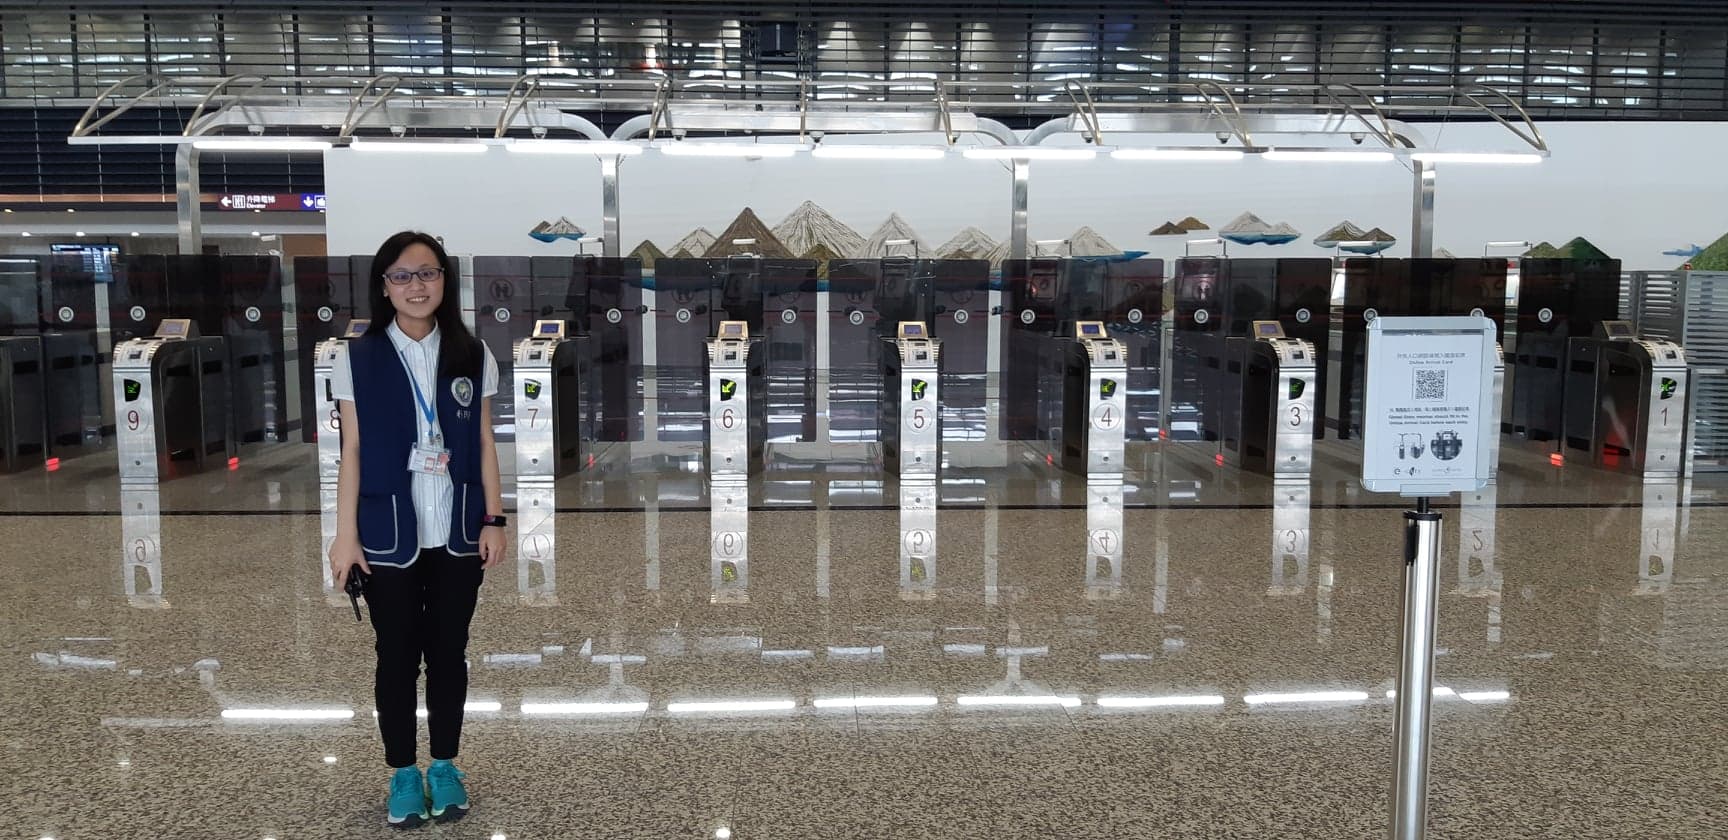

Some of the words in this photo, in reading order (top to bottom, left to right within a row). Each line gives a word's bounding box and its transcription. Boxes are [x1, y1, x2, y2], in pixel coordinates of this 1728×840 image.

[128, 410, 139, 430] 9
[330, 409, 341, 429] 8
[527, 408, 539, 428] 7
[723, 408, 734, 428] 6
[914, 408, 925, 429] 5
[1101, 407, 1112, 427] 4
[1290, 406, 1301, 426] 3
[1661, 407, 1668, 426] 1
